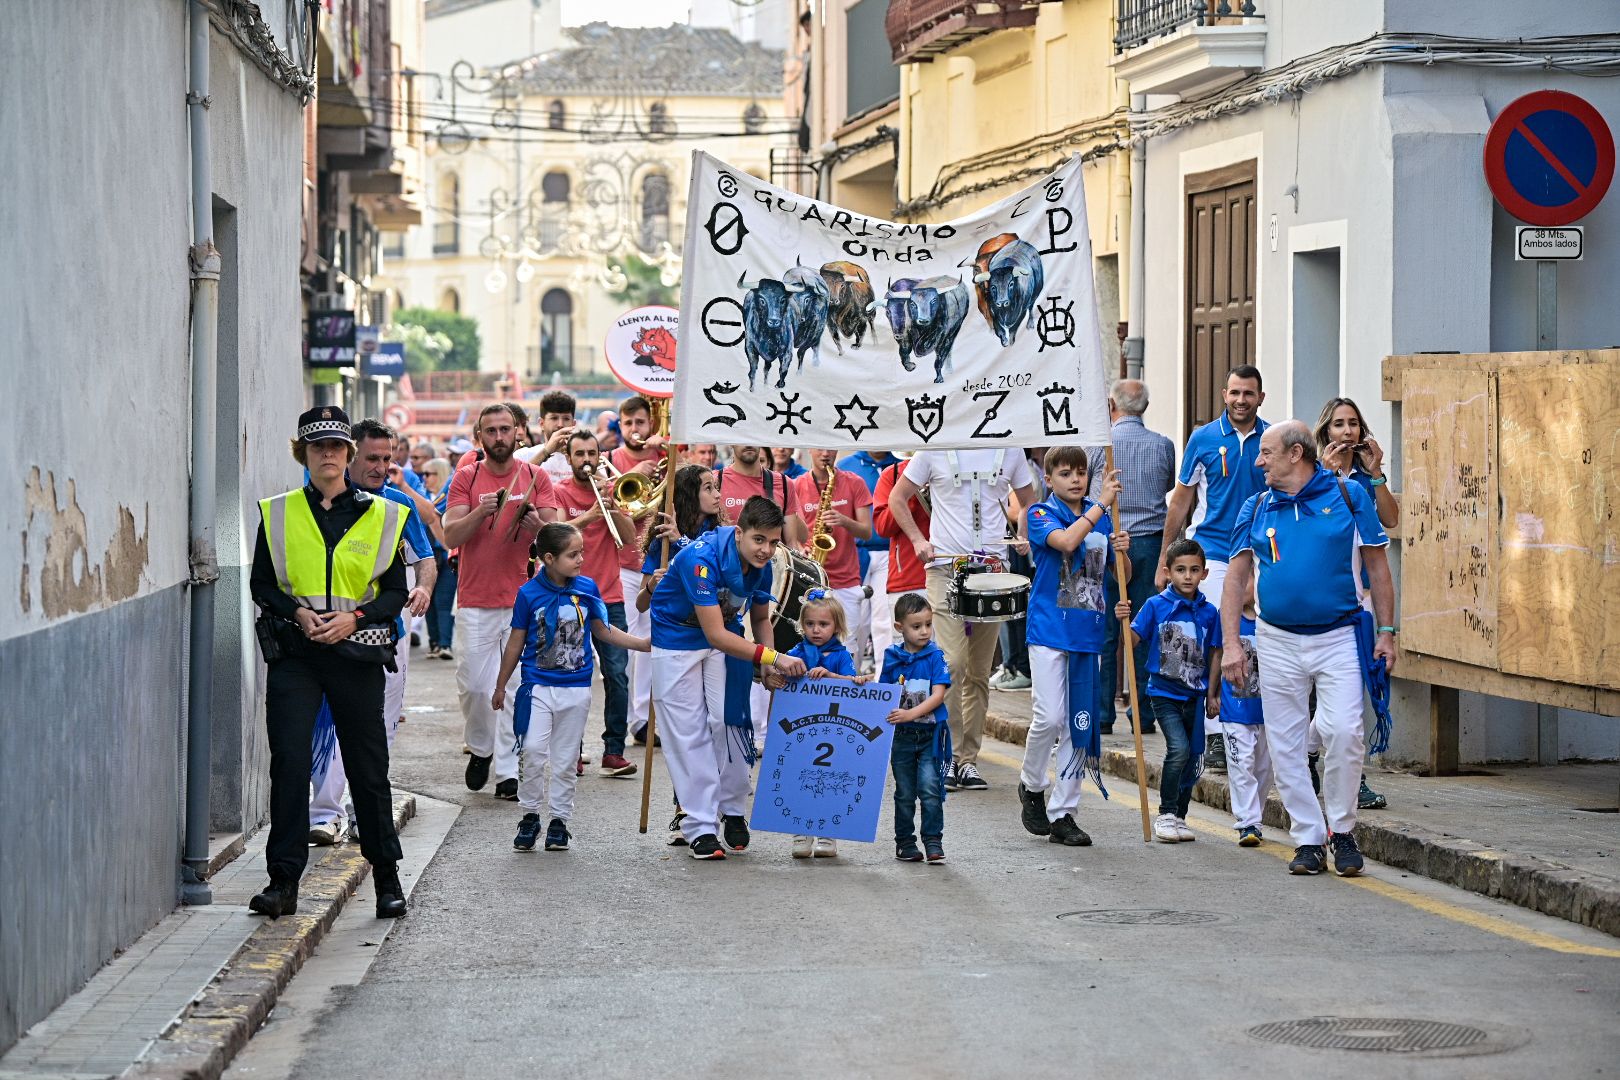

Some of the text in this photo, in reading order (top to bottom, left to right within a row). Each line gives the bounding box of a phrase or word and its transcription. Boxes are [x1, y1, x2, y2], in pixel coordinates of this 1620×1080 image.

[754, 190, 957, 243] GUARISMO
[1523, 239, 1578, 248] Ambos lados
[1534, 229, 1567, 239] 38 Mts.
[842, 239, 934, 265] Onda
[617, 315, 651, 327] LLENYA
[962, 372, 1032, 393] desde 2002
[800, 682, 893, 702] ANIVERSARIO
[791, 716, 816, 730] A.C.T.
[817, 715, 864, 731] GUARISMO
[812, 742, 835, 767] 2
